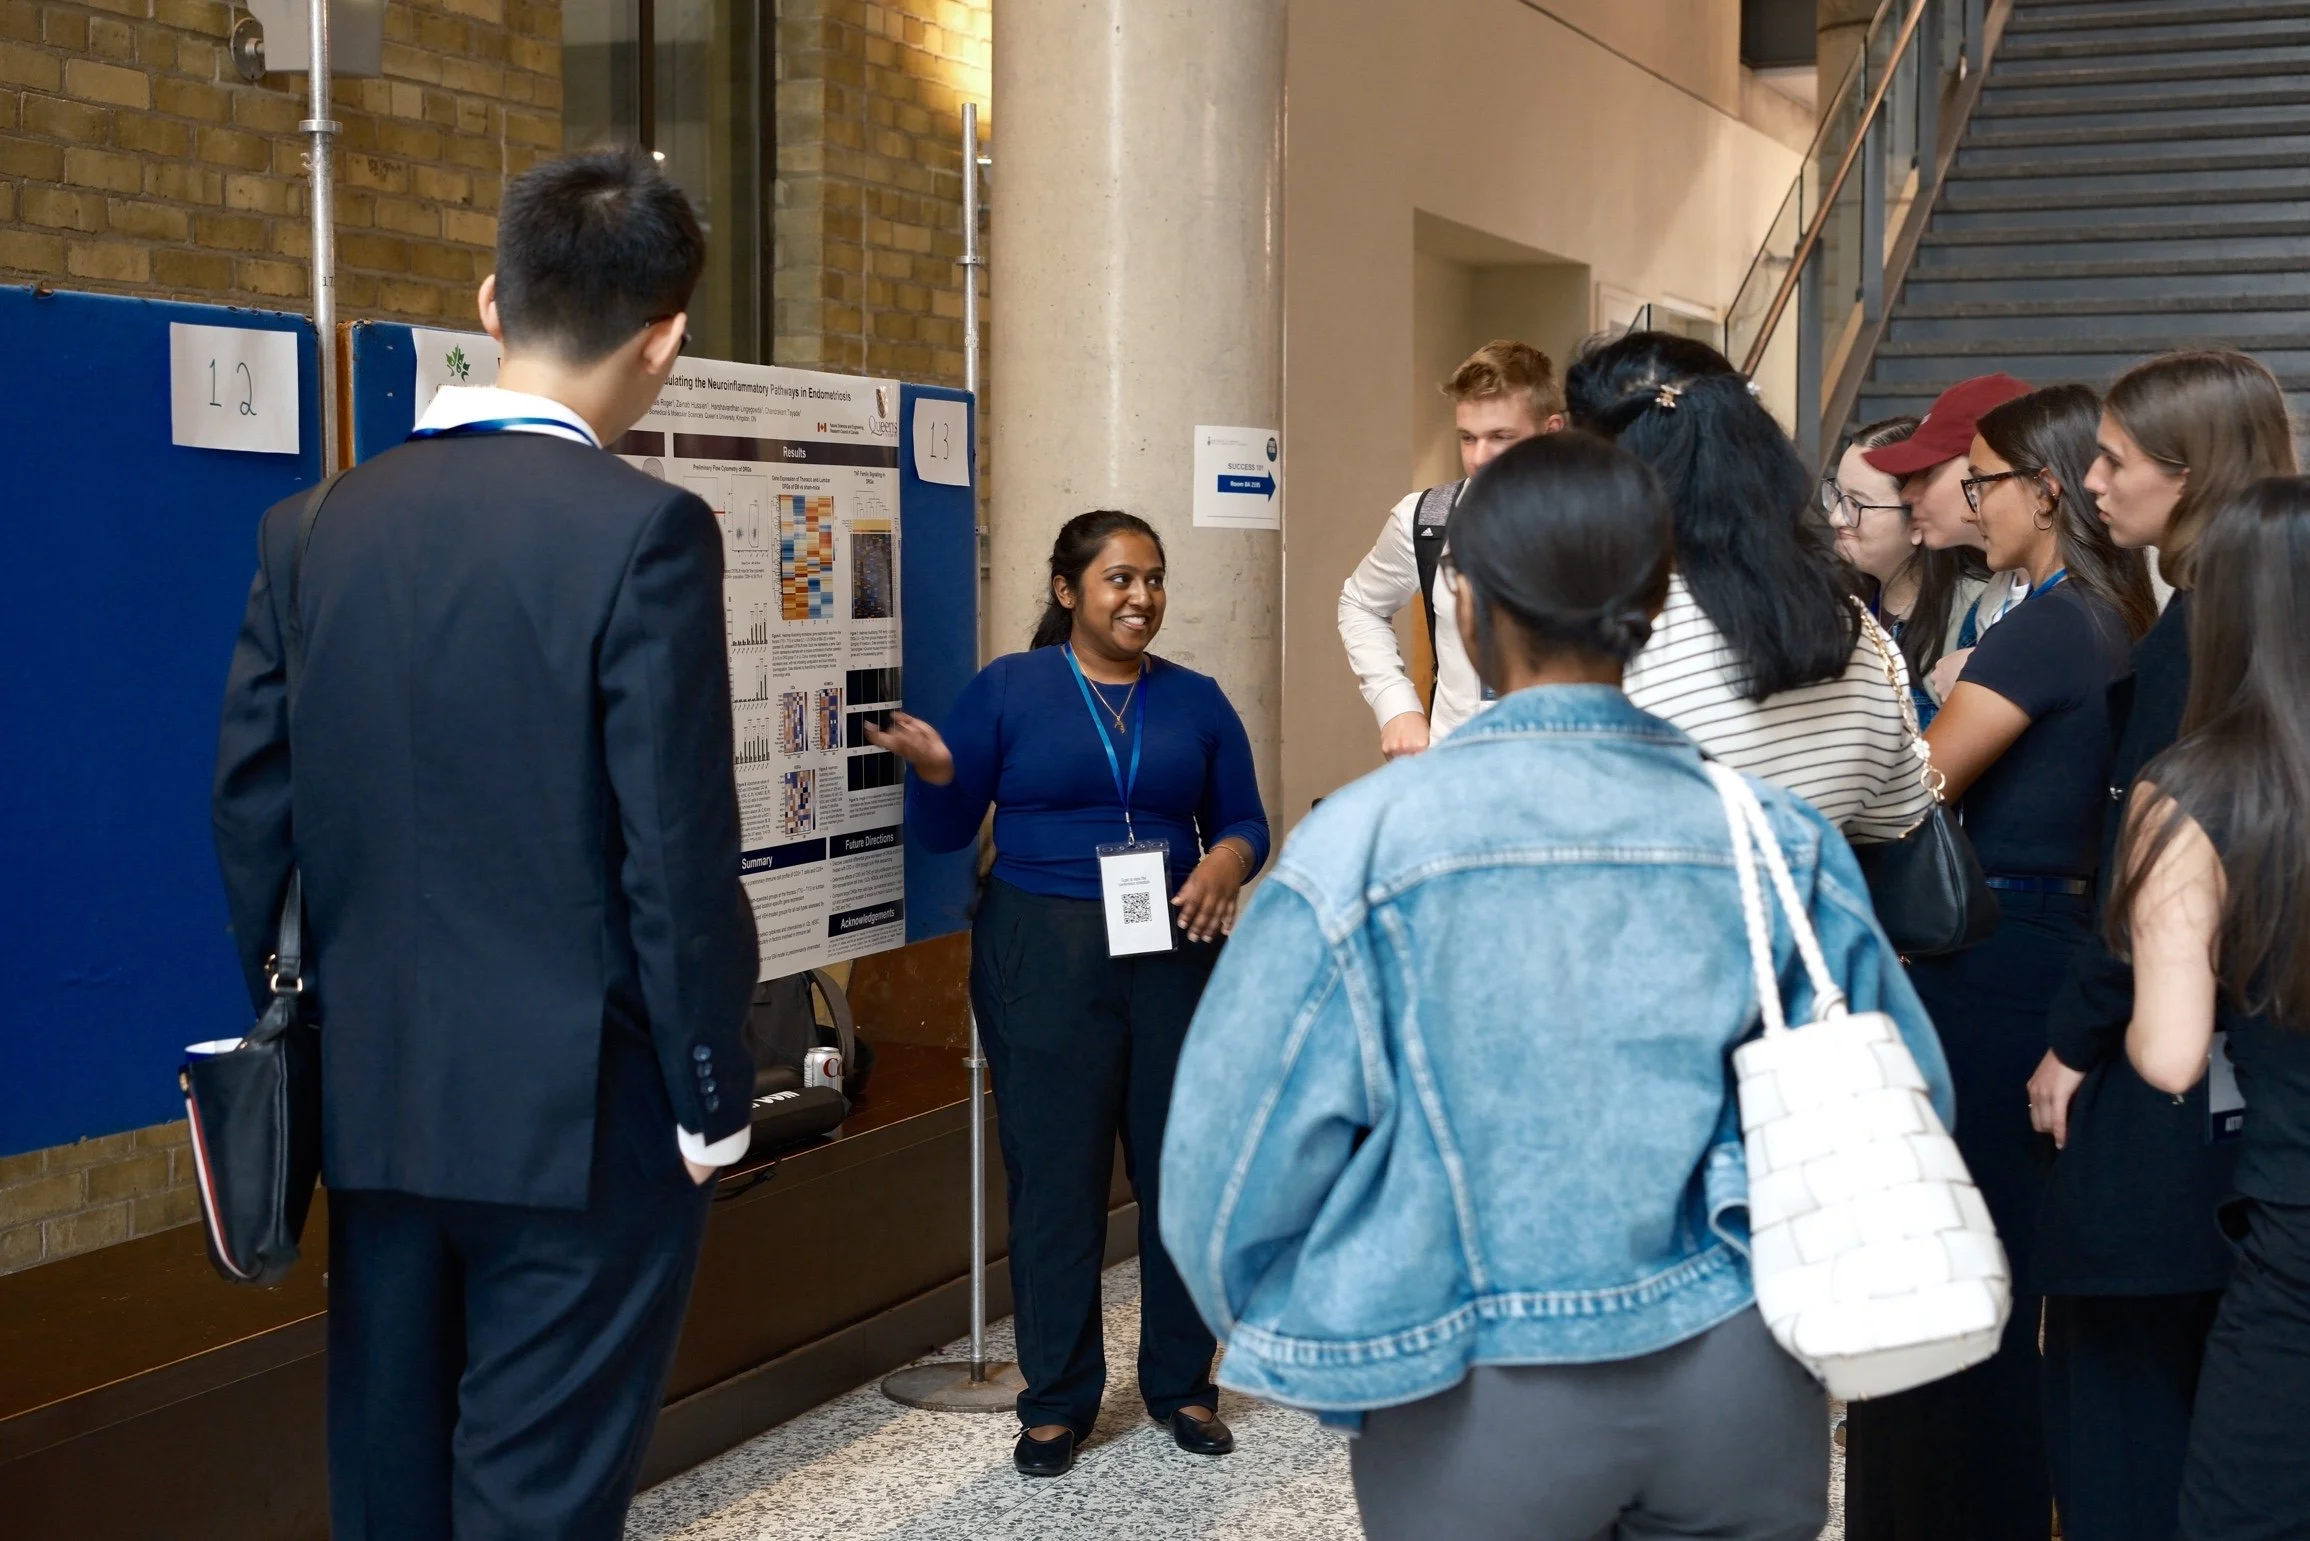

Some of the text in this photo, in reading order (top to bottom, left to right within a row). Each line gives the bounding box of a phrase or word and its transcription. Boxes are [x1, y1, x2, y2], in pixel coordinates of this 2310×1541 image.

[209, 359, 257, 416] 12
[695, 376, 706, 389] the
[707, 378, 769, 397] Neuroinflammatory
[770, 384, 799, 400] Pathways
[800, 386, 807, 398] in
[808, 387, 852, 402] Endometriosis
[868, 415, 898, 437] Queen's
[930, 421, 949, 460] 13
[783, 446, 806, 459] Results
[1228, 463, 1255, 471] SUCCESS
[845, 832, 894, 851] Future Directions
[741, 854, 773, 870] Summary
[840, 907, 895, 930] Acknowledgements
